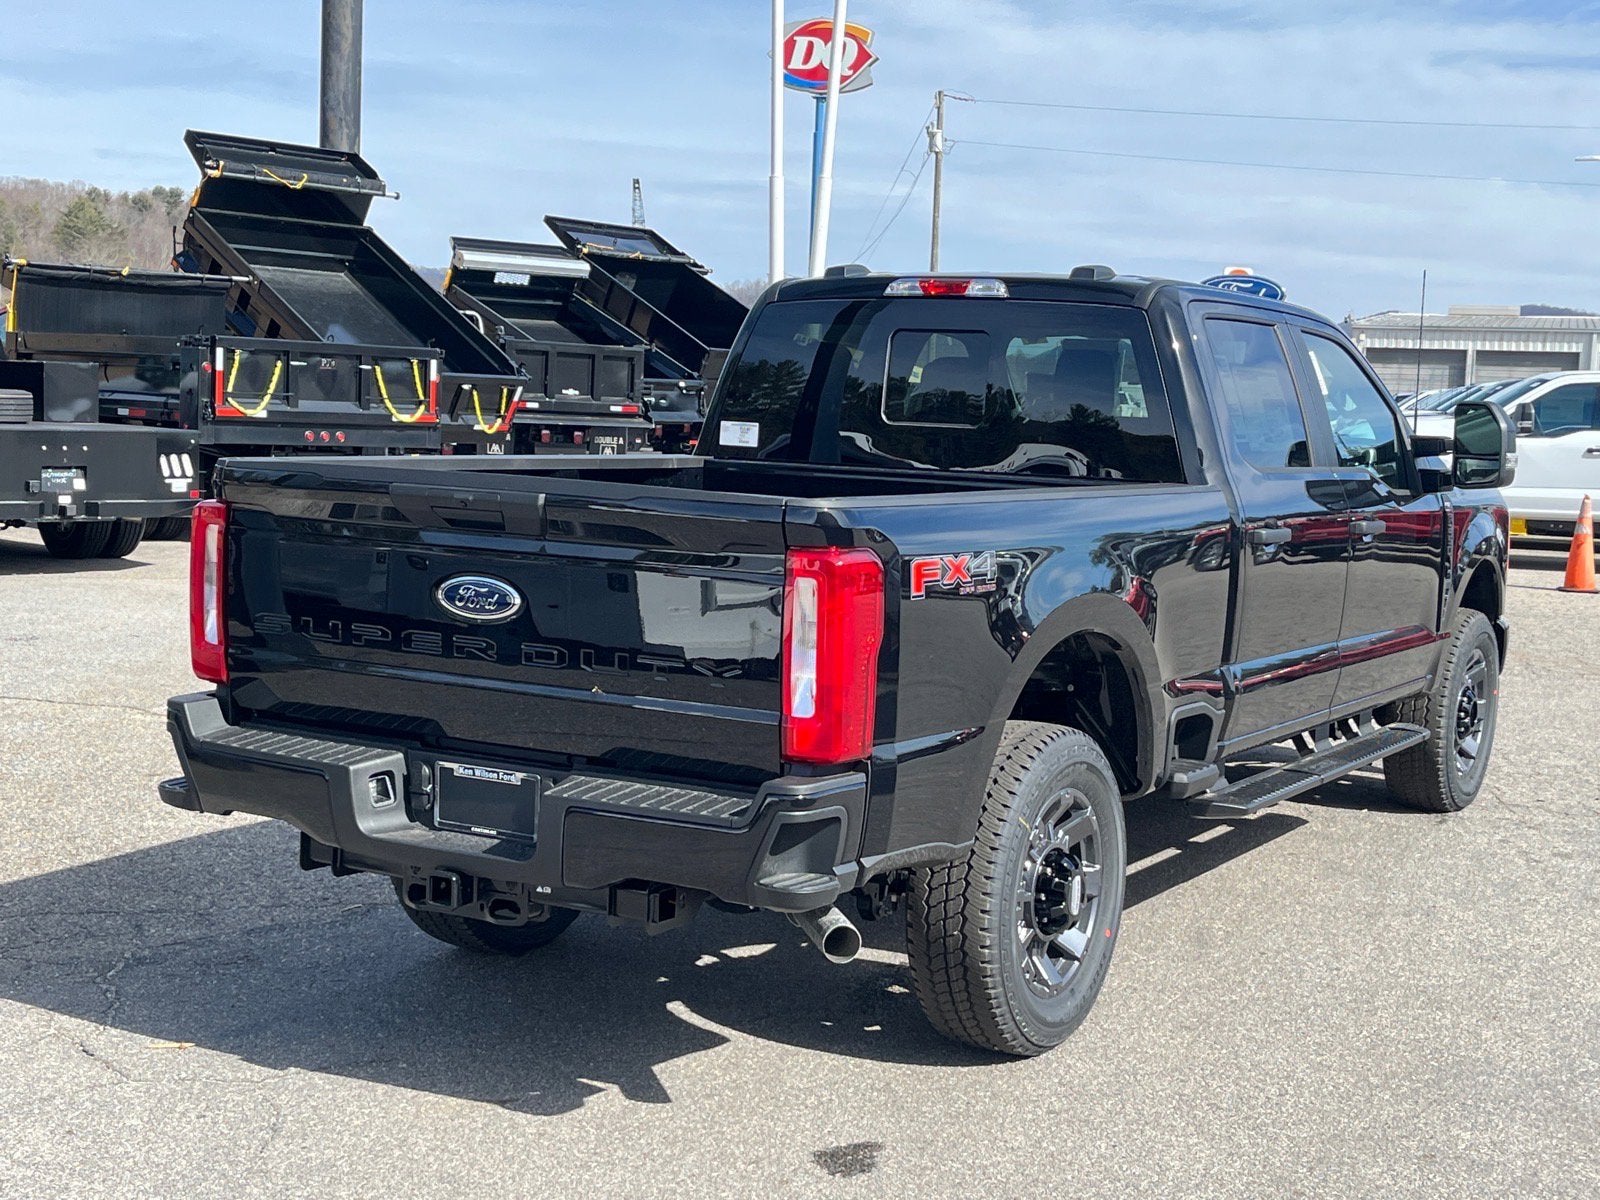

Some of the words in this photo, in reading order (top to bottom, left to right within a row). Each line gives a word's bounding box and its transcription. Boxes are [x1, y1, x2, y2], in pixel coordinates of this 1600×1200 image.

[787, 36, 858, 76] DQ
[594, 435, 618, 445] DOUBLE
[618, 437, 624, 445] A
[911, 551, 997, 600] FX4
[455, 584, 499, 610] Ford
[254, 612, 497, 662] SUPER
[521, 642, 743, 688] DUTY
[459, 766, 473, 776] Ken
[474, 767, 497, 780] Wilson
[499, 772, 515, 782] Ford
